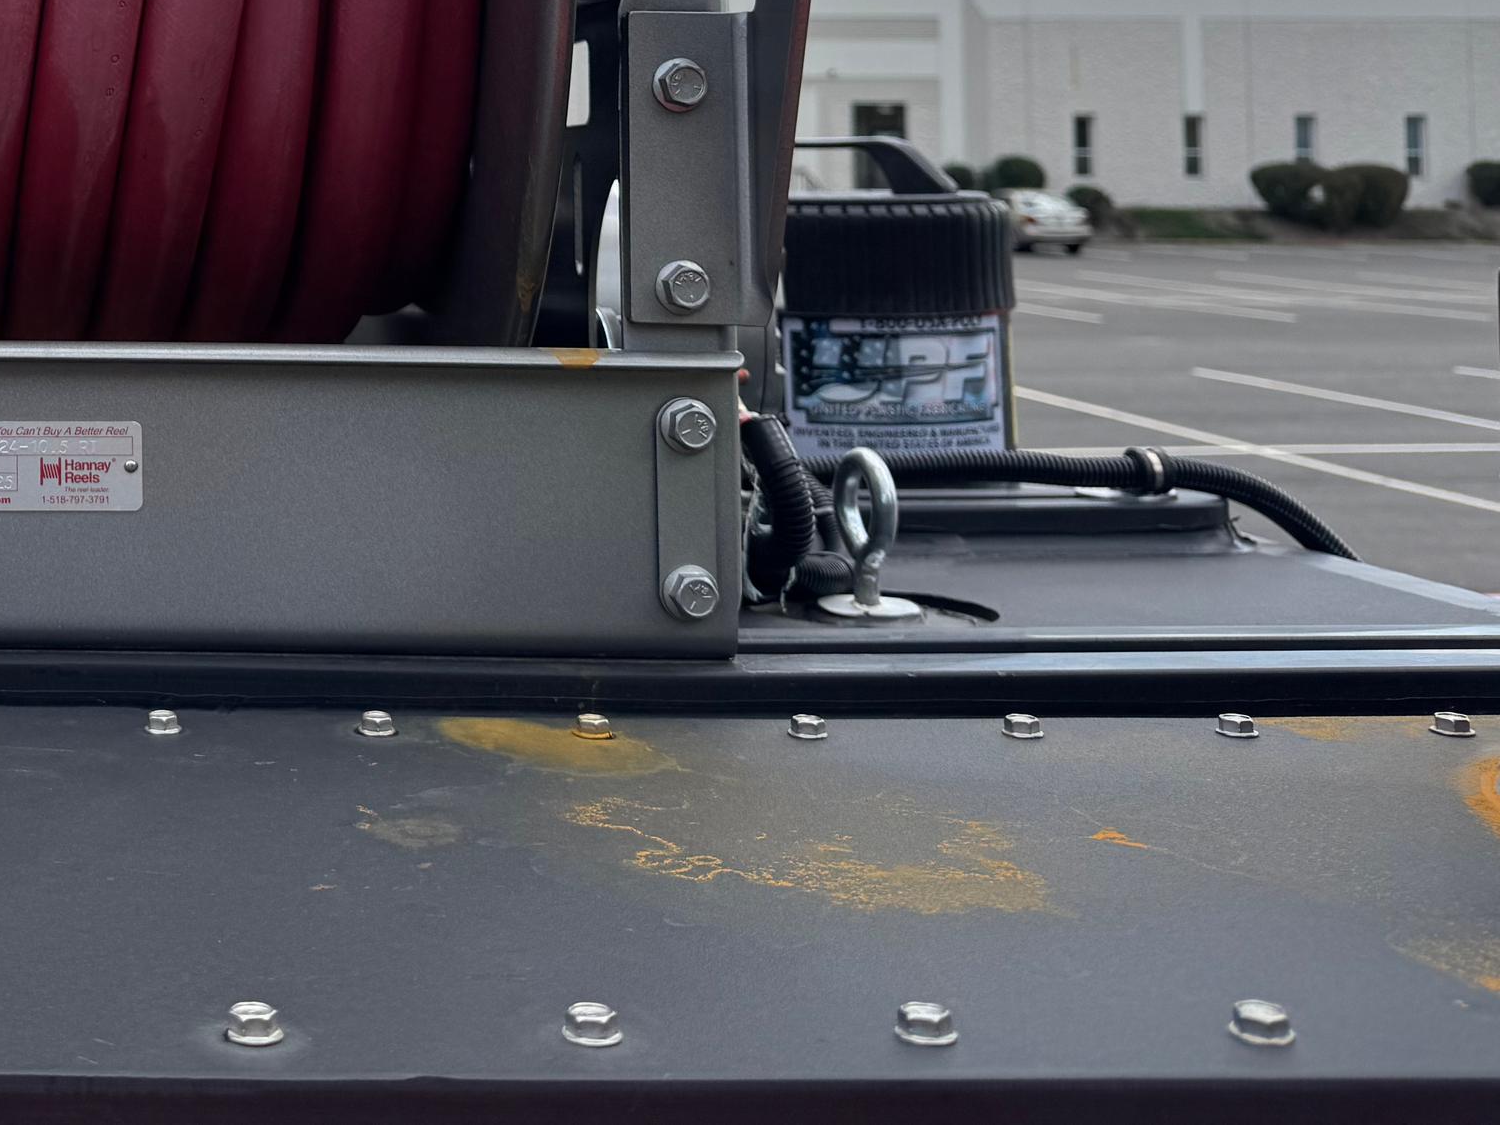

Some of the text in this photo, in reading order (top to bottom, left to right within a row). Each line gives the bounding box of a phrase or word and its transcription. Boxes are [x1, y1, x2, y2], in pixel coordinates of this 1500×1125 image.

[15, 426, 41, 436] Can't
[43, 426, 61, 437] Buy
[64, 426, 72, 435] A
[74, 426, 103, 436] Better
[105, 426, 129, 436] Reel
[64, 472, 101, 484] Reels
[41, 495, 110, 505] 1-518-797-3791
